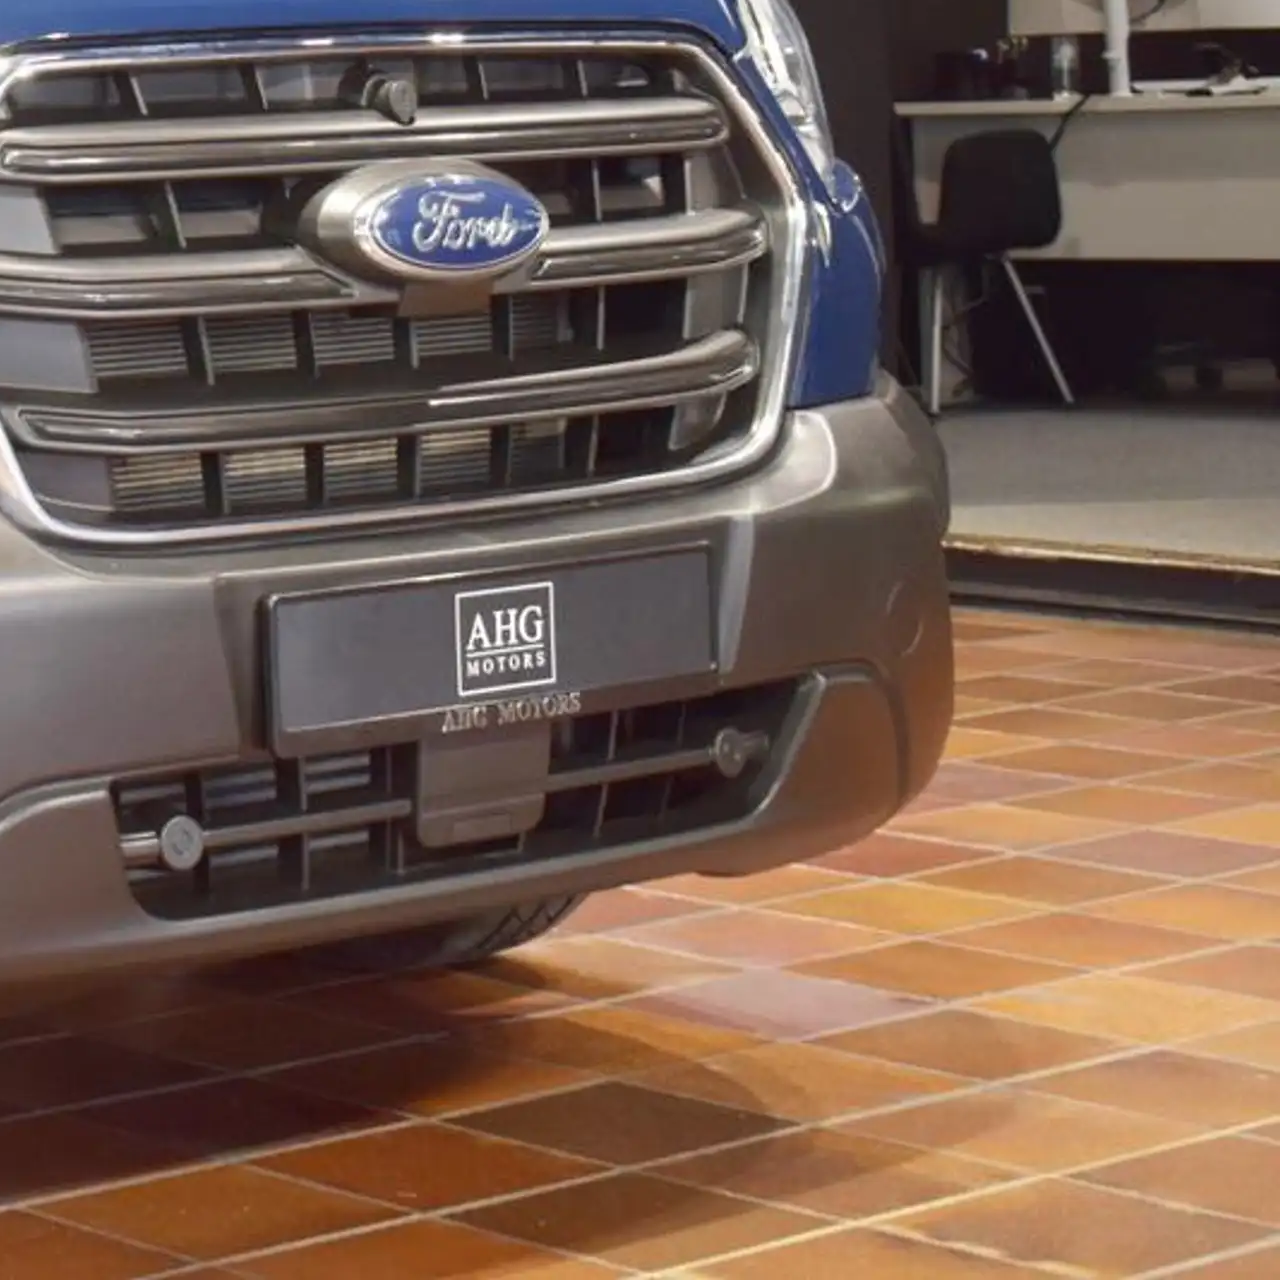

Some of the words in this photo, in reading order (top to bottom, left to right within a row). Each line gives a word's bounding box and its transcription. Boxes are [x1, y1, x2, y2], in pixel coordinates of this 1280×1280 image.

[412, 190, 521, 253] Ford
[465, 604, 545, 651] AHG
[466, 651, 546, 677] MOTORS
[442, 704, 488, 734] AHG
[498, 692, 582, 726] MOTORS
